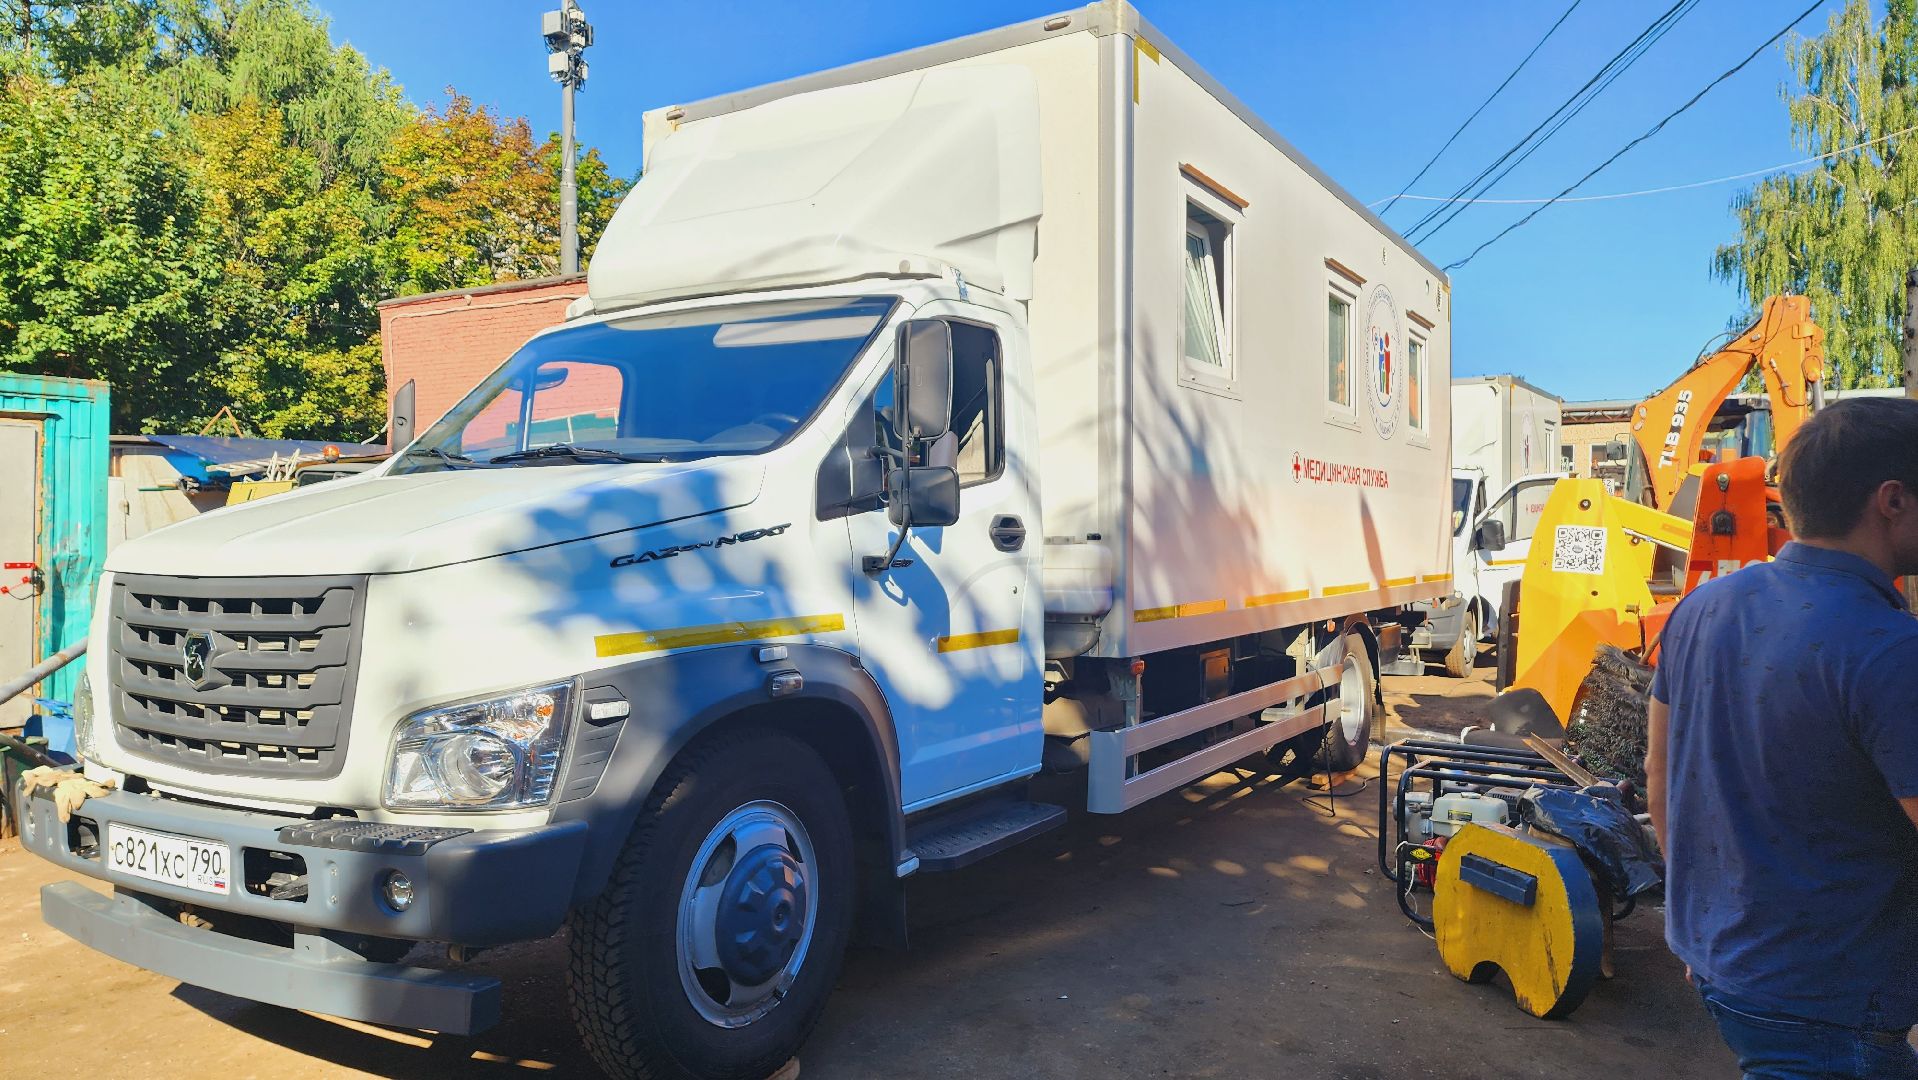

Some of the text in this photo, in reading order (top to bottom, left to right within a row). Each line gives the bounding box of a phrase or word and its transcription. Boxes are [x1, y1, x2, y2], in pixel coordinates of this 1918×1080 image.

[1658, 390, 1693, 469] TLB 935
[1303, 457, 1389, 489] МЕДИЦИНСКАЯ СЛУЖБА
[190, 846, 222, 876] 790
[197, 875, 213, 886] RUS
